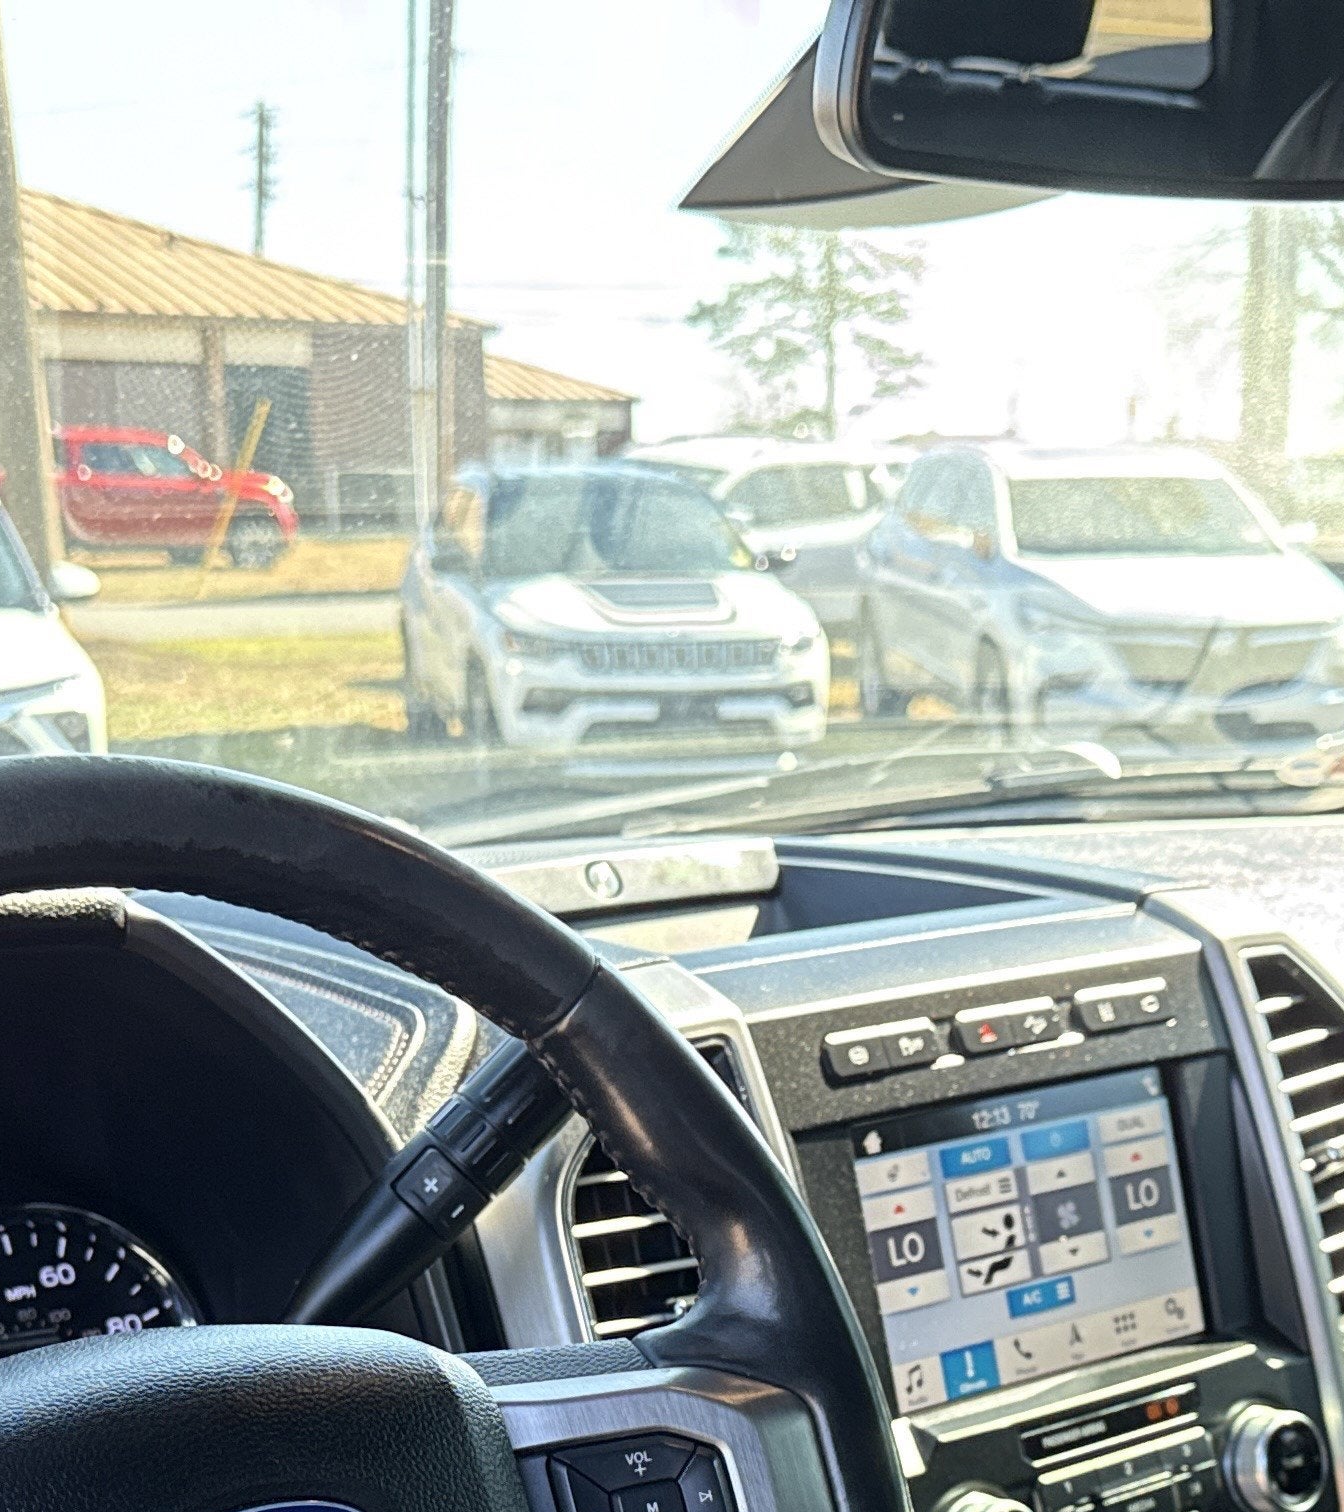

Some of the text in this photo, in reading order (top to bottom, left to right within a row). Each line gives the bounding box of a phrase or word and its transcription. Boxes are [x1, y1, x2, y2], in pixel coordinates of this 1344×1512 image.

[960, 1146, 992, 1165] AUTO
[1125, 1177, 1160, 1211] LO
[887, 1231, 926, 1268] LO
[39, 1262, 76, 1289] 60
[3, 1284, 37, 1302] MPH
[106, 1313, 143, 1336] 80
[624, 1450, 653, 1466] VOL
